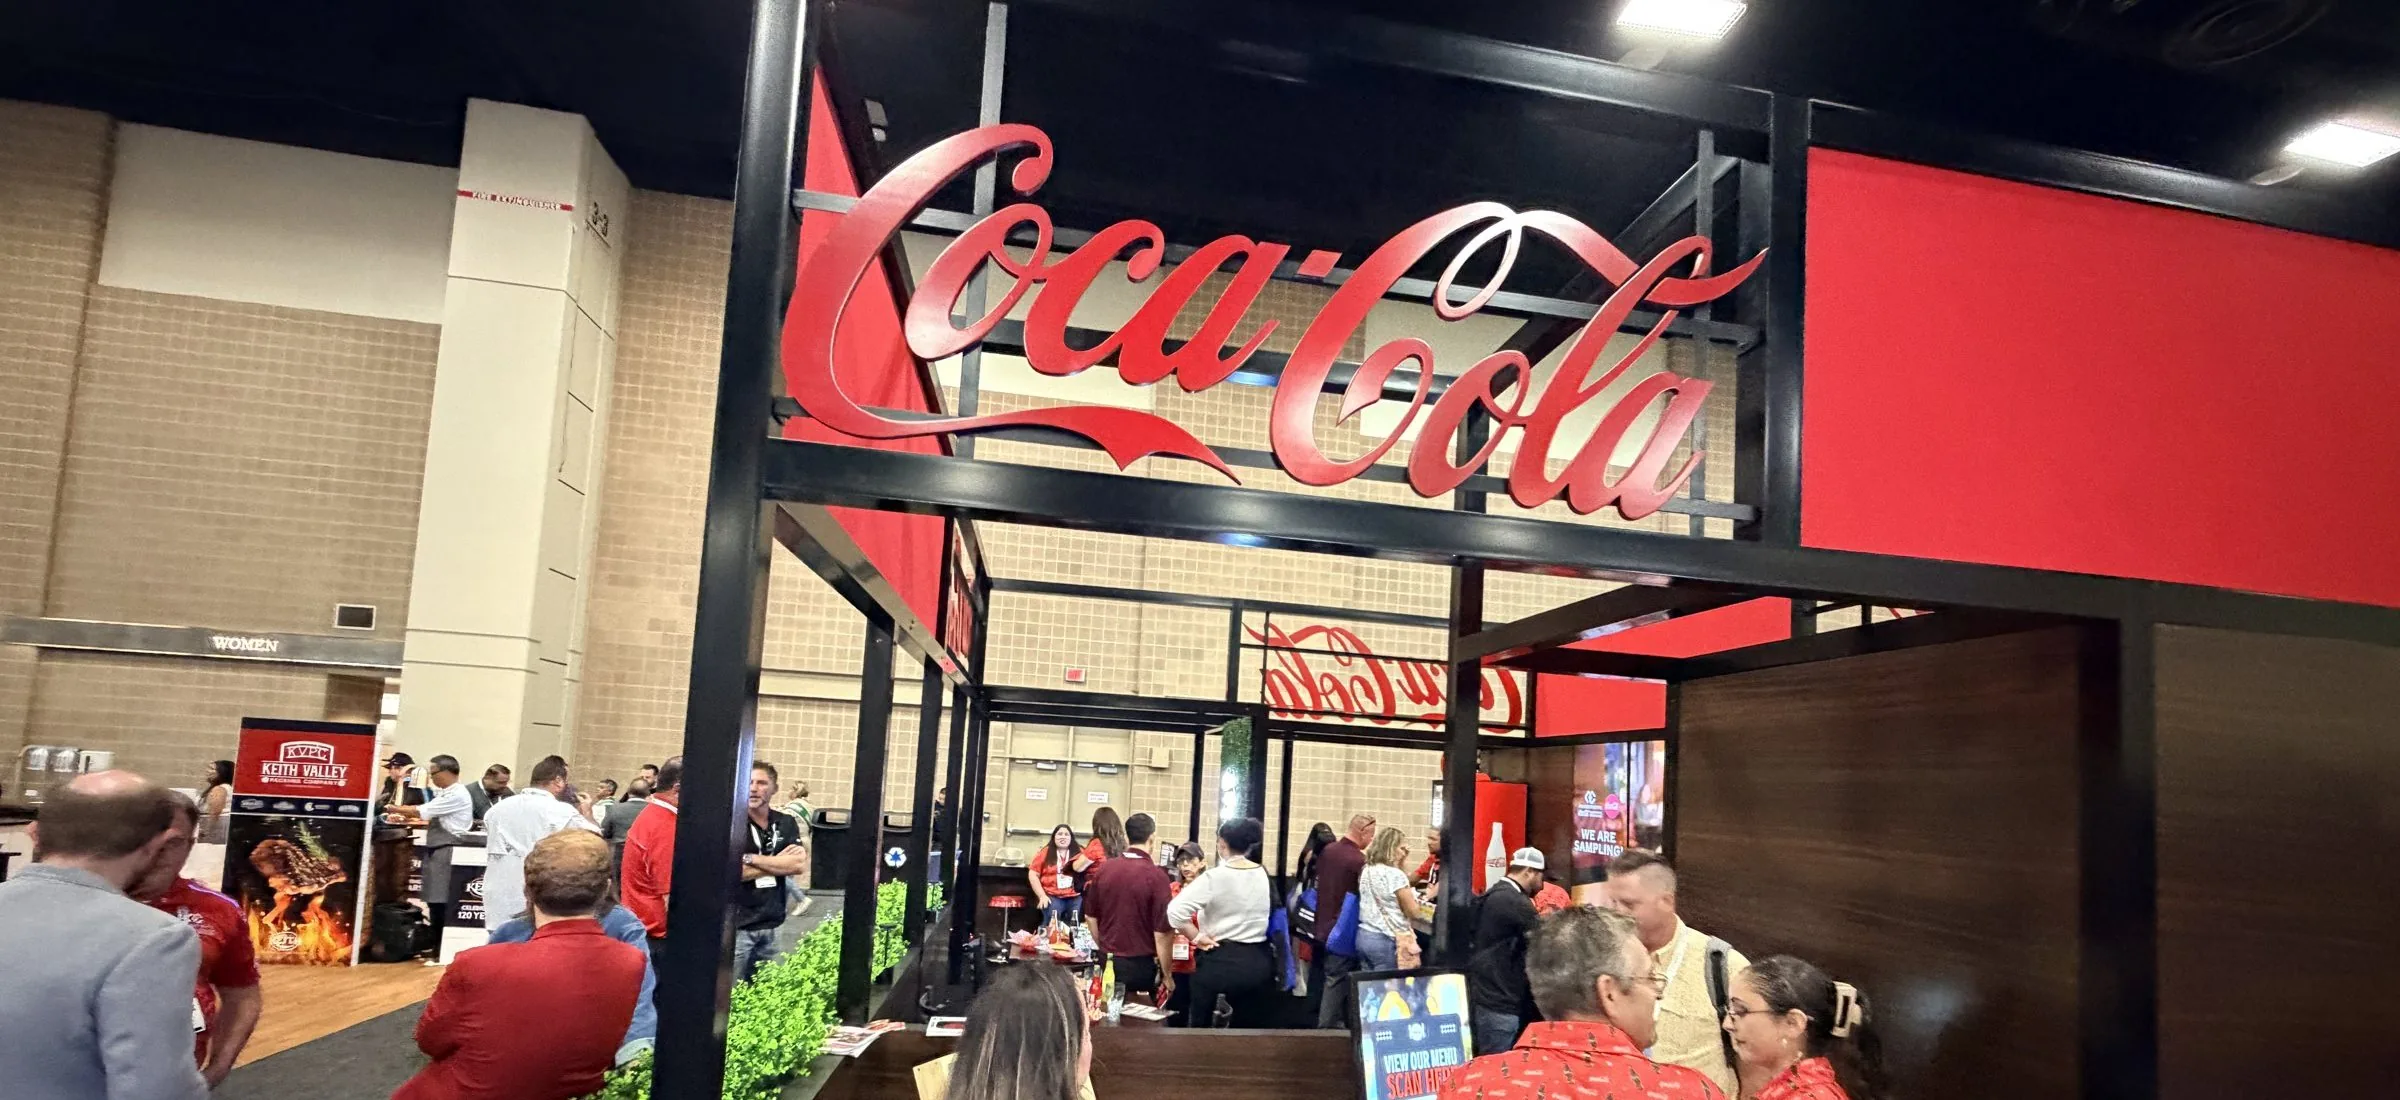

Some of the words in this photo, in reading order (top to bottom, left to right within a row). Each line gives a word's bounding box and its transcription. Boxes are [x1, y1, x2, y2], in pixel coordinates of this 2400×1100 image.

[781, 123, 1770, 520] Coca-Cola
[212, 635, 279, 652] WOMEN
[285, 745, 329, 761] KVPC
[262, 763, 298, 777] KEITH
[303, 764, 348, 778] VALLEY
[1581, 828, 1595, 841] WE
[1597, 830, 1616, 844] ARE
[1574, 840, 1624, 857] SAMPLING!
[457, 911, 472, 919] 120
[1383, 1052, 1409, 1074] VIEW
[1410, 1050, 1430, 1071] OUR
[1430, 1047, 1458, 1067] MENU
[1386, 1070, 1423, 1099] SCAN
[1425, 1066, 1455, 1093] HE
